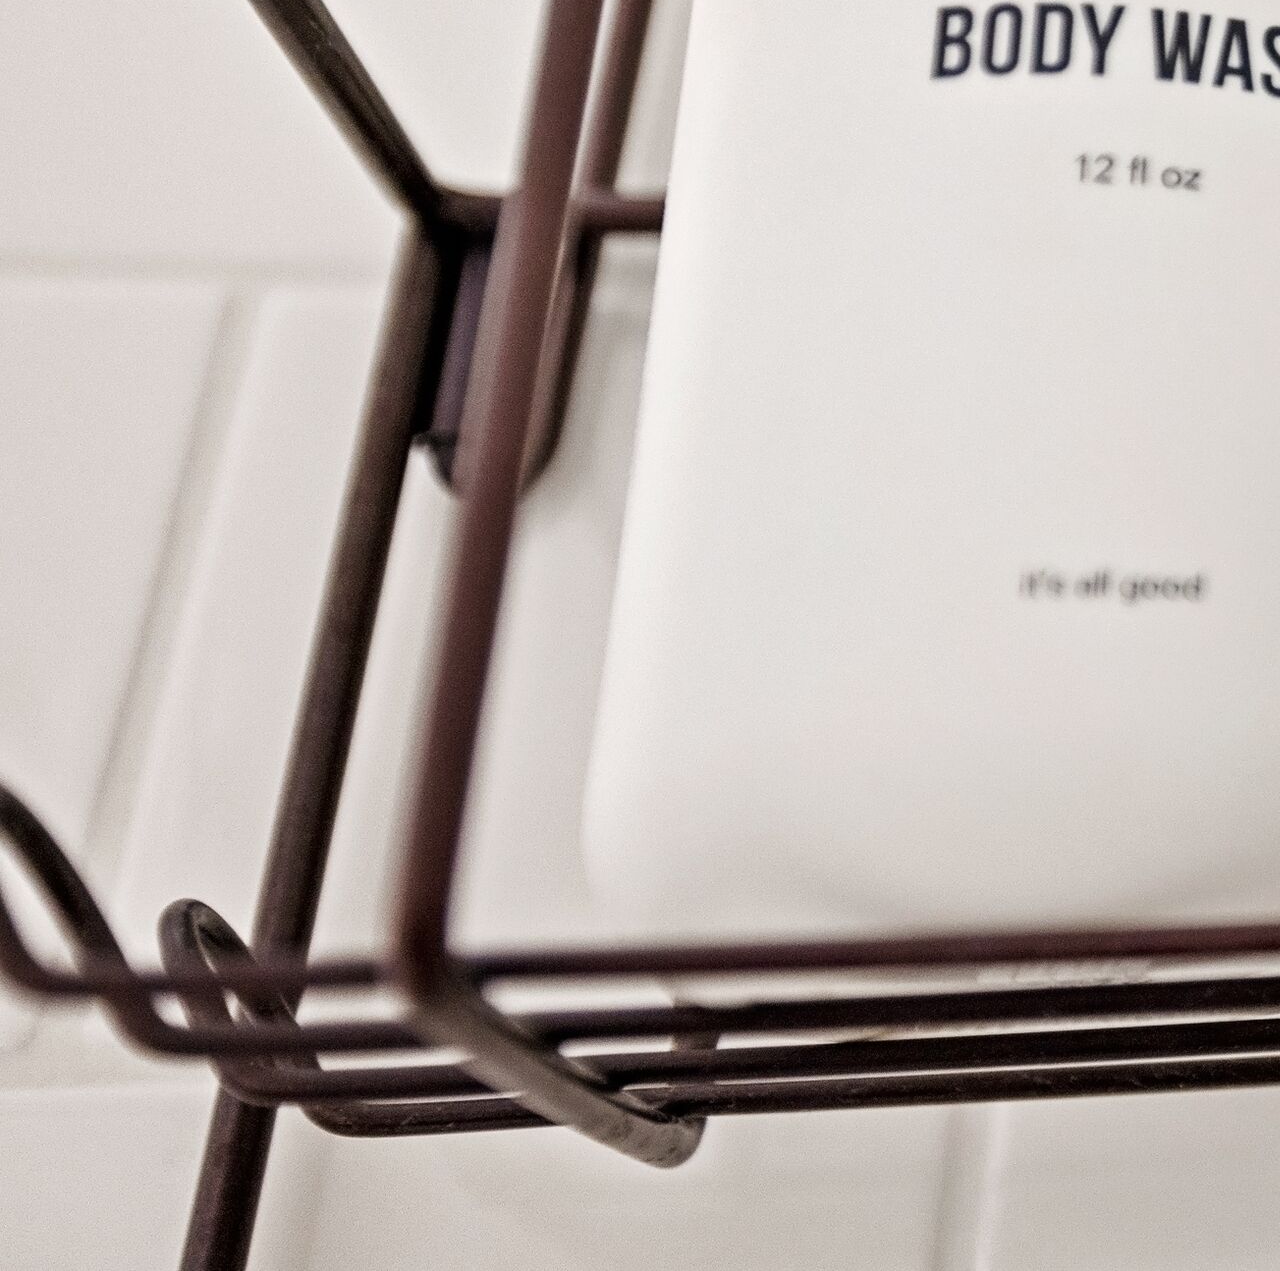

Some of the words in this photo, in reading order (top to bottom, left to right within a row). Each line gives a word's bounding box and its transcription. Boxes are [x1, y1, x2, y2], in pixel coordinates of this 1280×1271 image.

[929, 1, 1128, 81] BODY
[1075, 152, 1117, 186] 12
[1127, 154, 1151, 187] fl
[1160, 165, 1203, 193] oz
